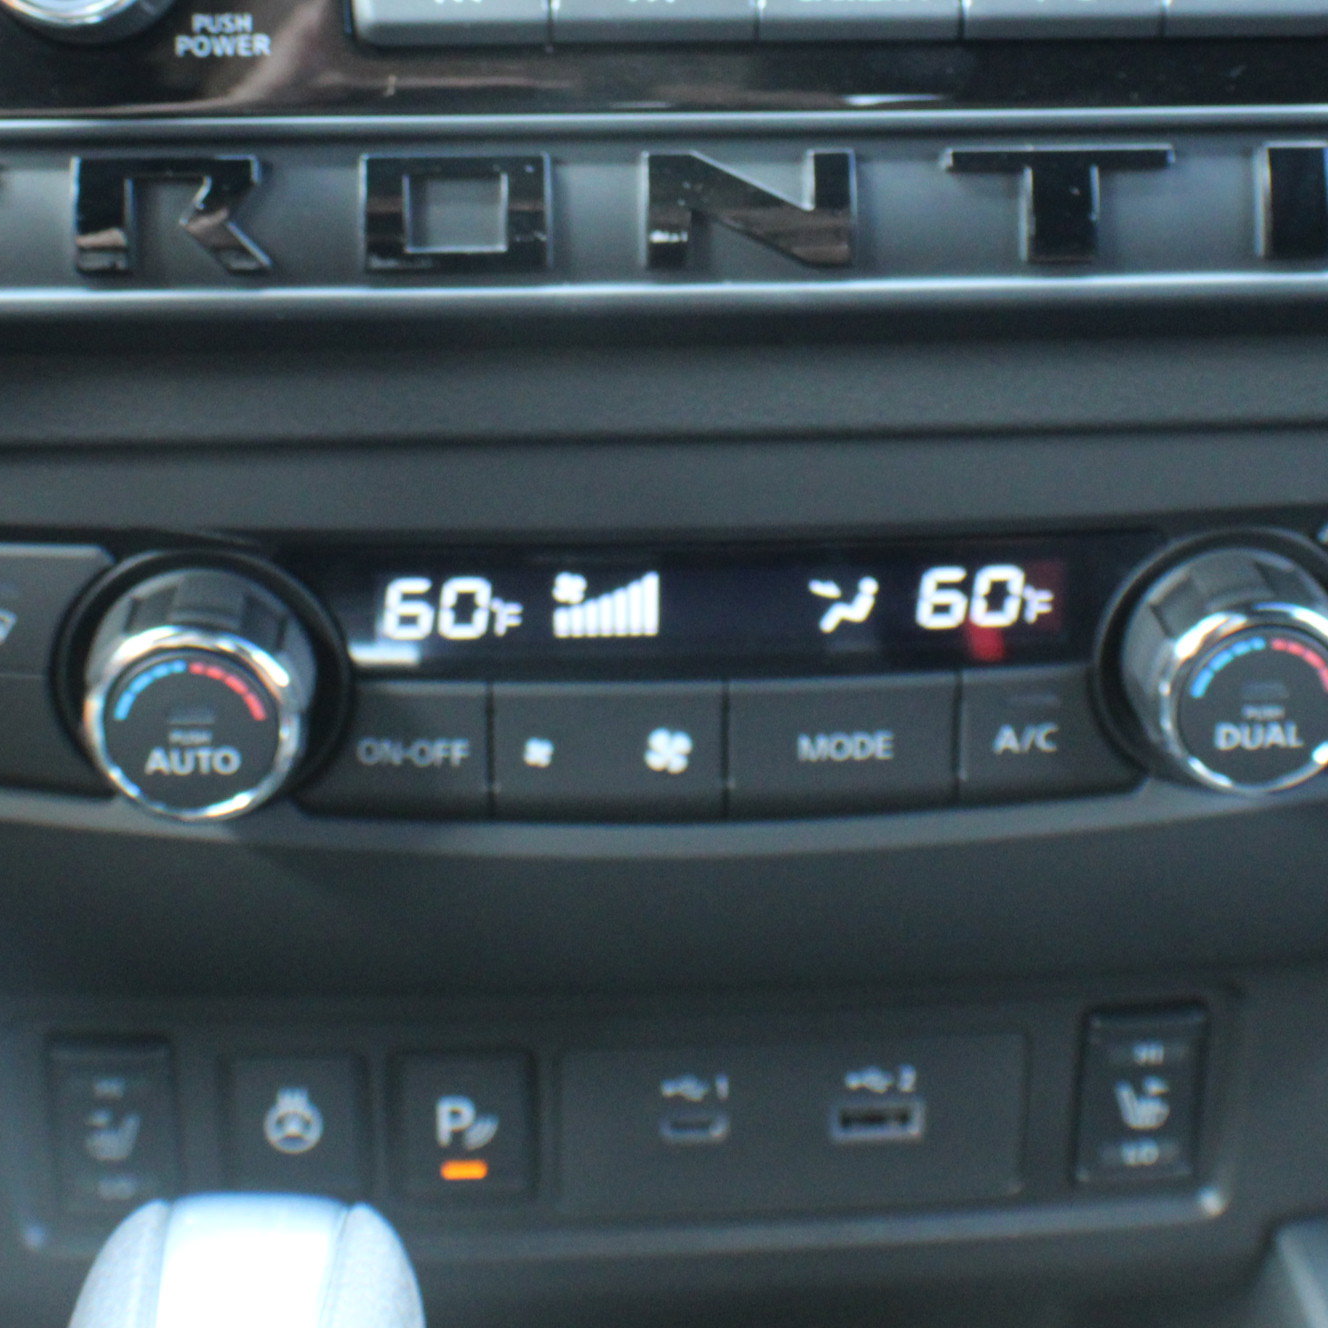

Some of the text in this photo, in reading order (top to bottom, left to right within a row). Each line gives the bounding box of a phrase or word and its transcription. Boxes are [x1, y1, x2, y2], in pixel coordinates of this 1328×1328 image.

[192, 13, 252, 35] PUSH
[176, 34, 270, 58] POWER
[797, 732, 894, 762] MODE
[993, 726, 1059, 756] A/C
[1215, 722, 1304, 751] DUAL
[144, 745, 242, 776] AUTO
